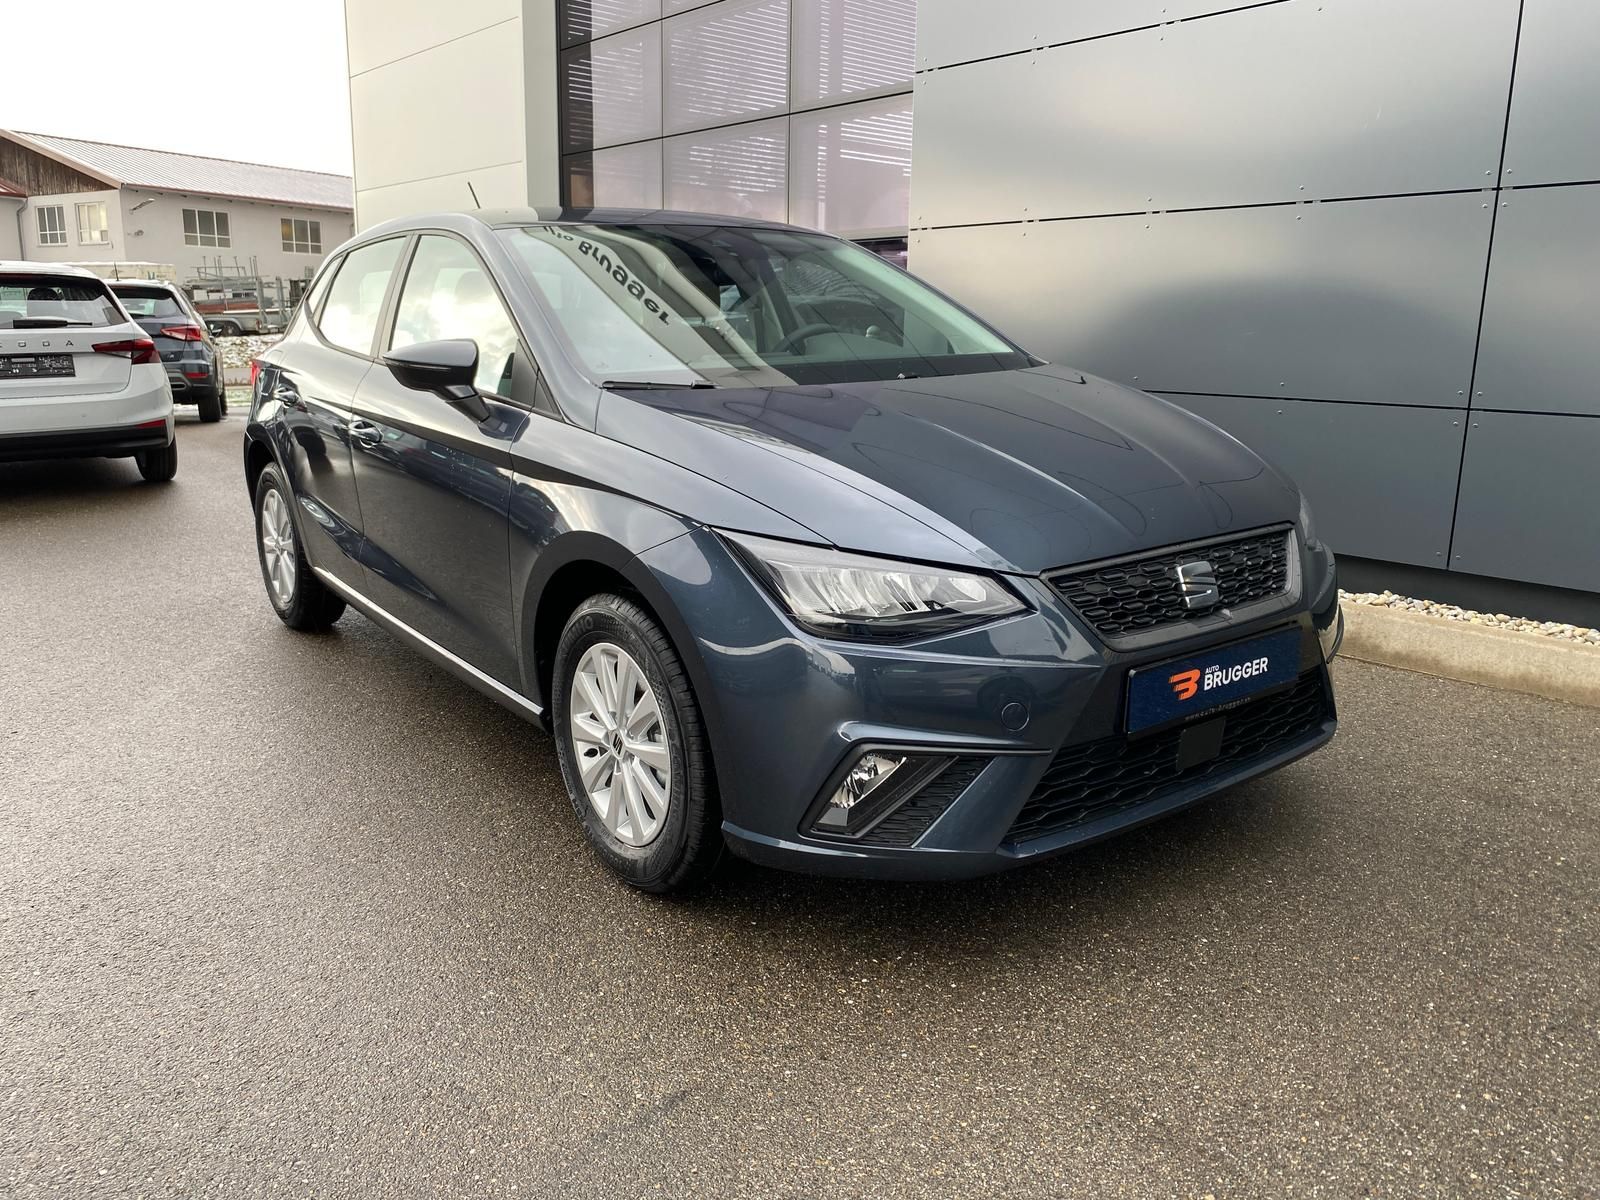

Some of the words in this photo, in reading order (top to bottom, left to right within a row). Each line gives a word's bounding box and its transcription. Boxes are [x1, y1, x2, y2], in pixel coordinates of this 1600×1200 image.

[0, 340, 74, 348] ODA
[1203, 656, 1269, 691] BRUGGER
[1205, 664, 1220, 674] AUTO
